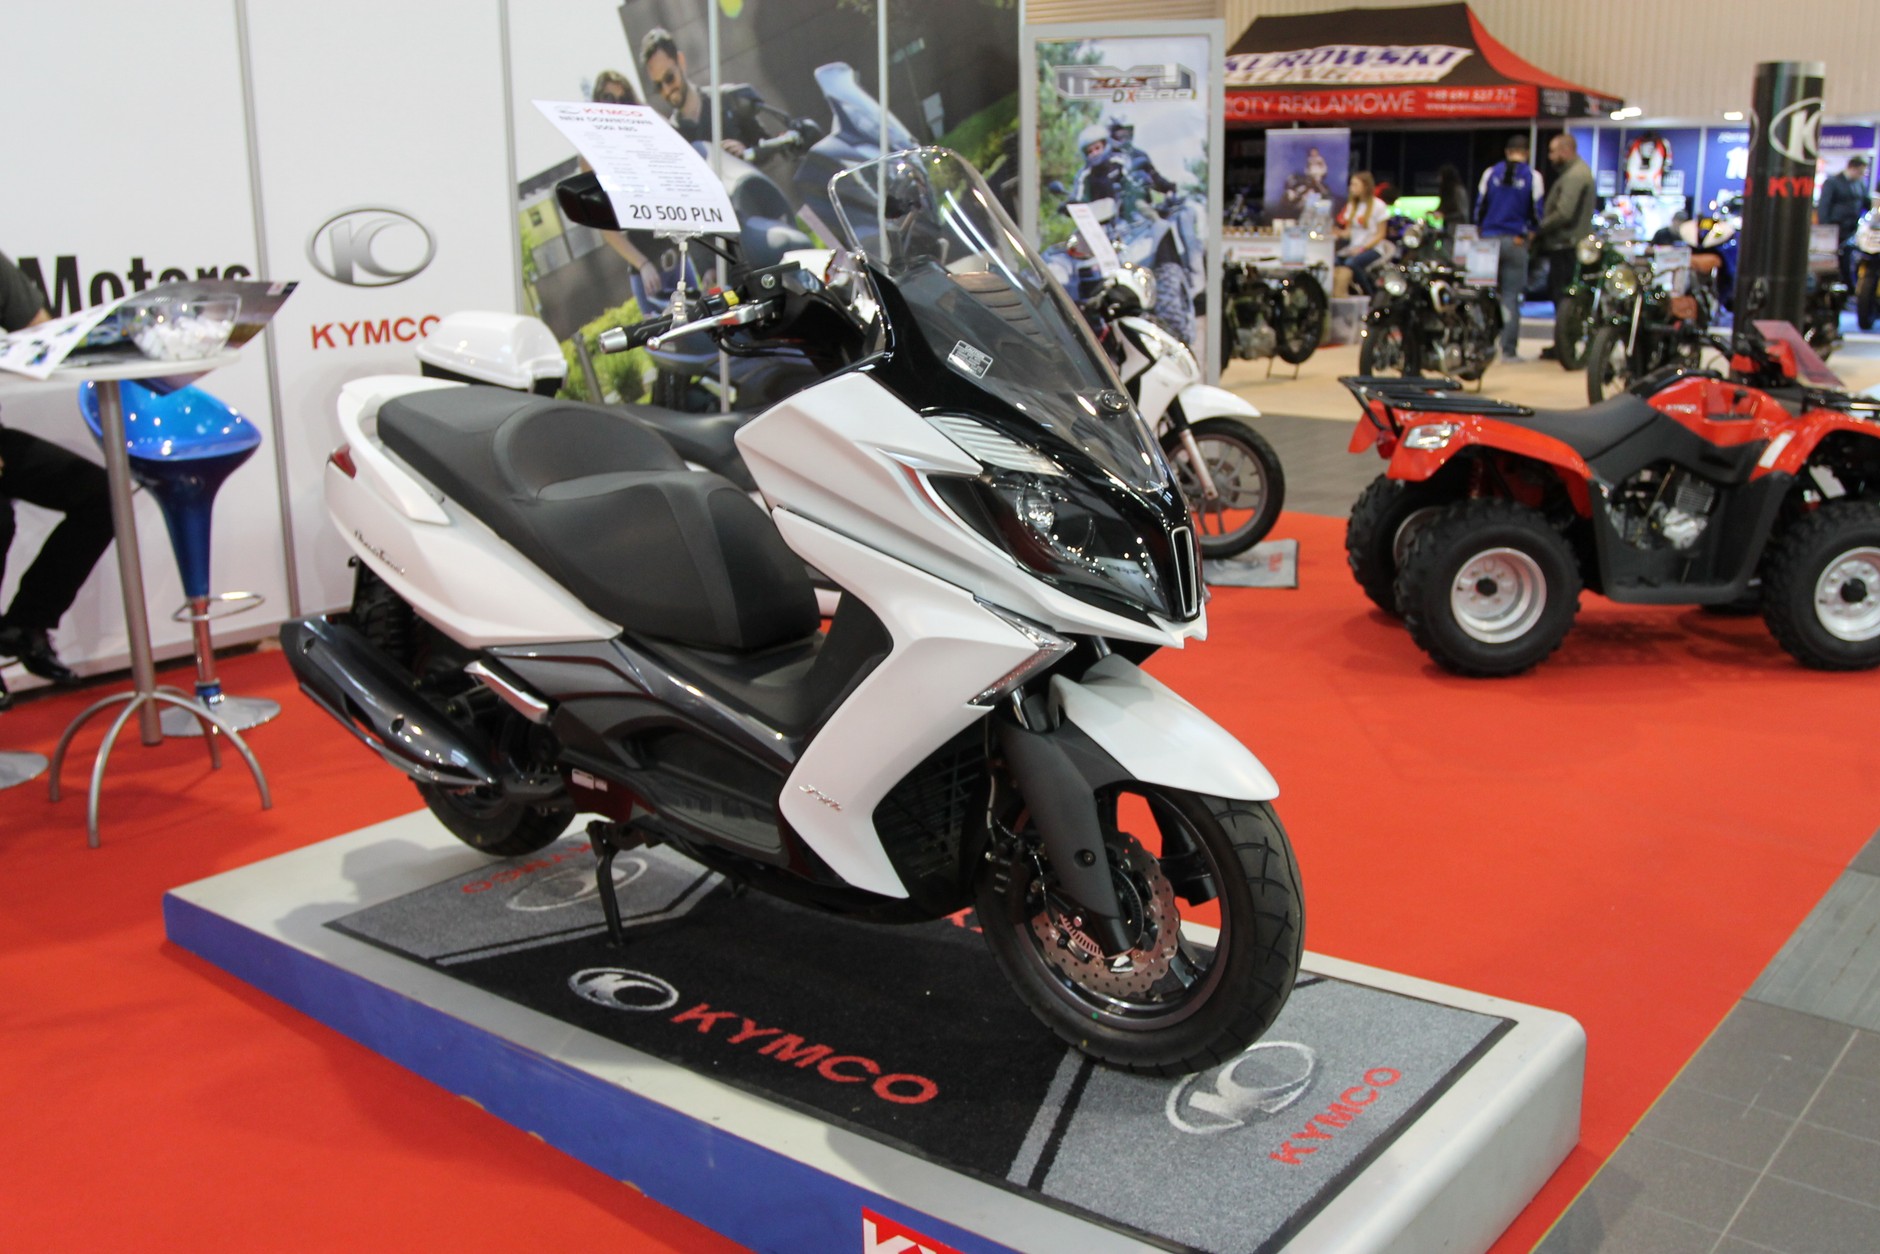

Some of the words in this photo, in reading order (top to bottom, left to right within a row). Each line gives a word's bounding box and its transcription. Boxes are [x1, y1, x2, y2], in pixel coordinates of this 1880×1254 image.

[1279, 90, 1417, 115] REKLAMOWE
[630, 204, 652, 220] 20
[656, 205, 688, 222] 500
[692, 206, 724, 224] PLN
[671, 1003, 939, 1105] KYMCO
[1269, 1067, 1402, 1165] KYMCO
